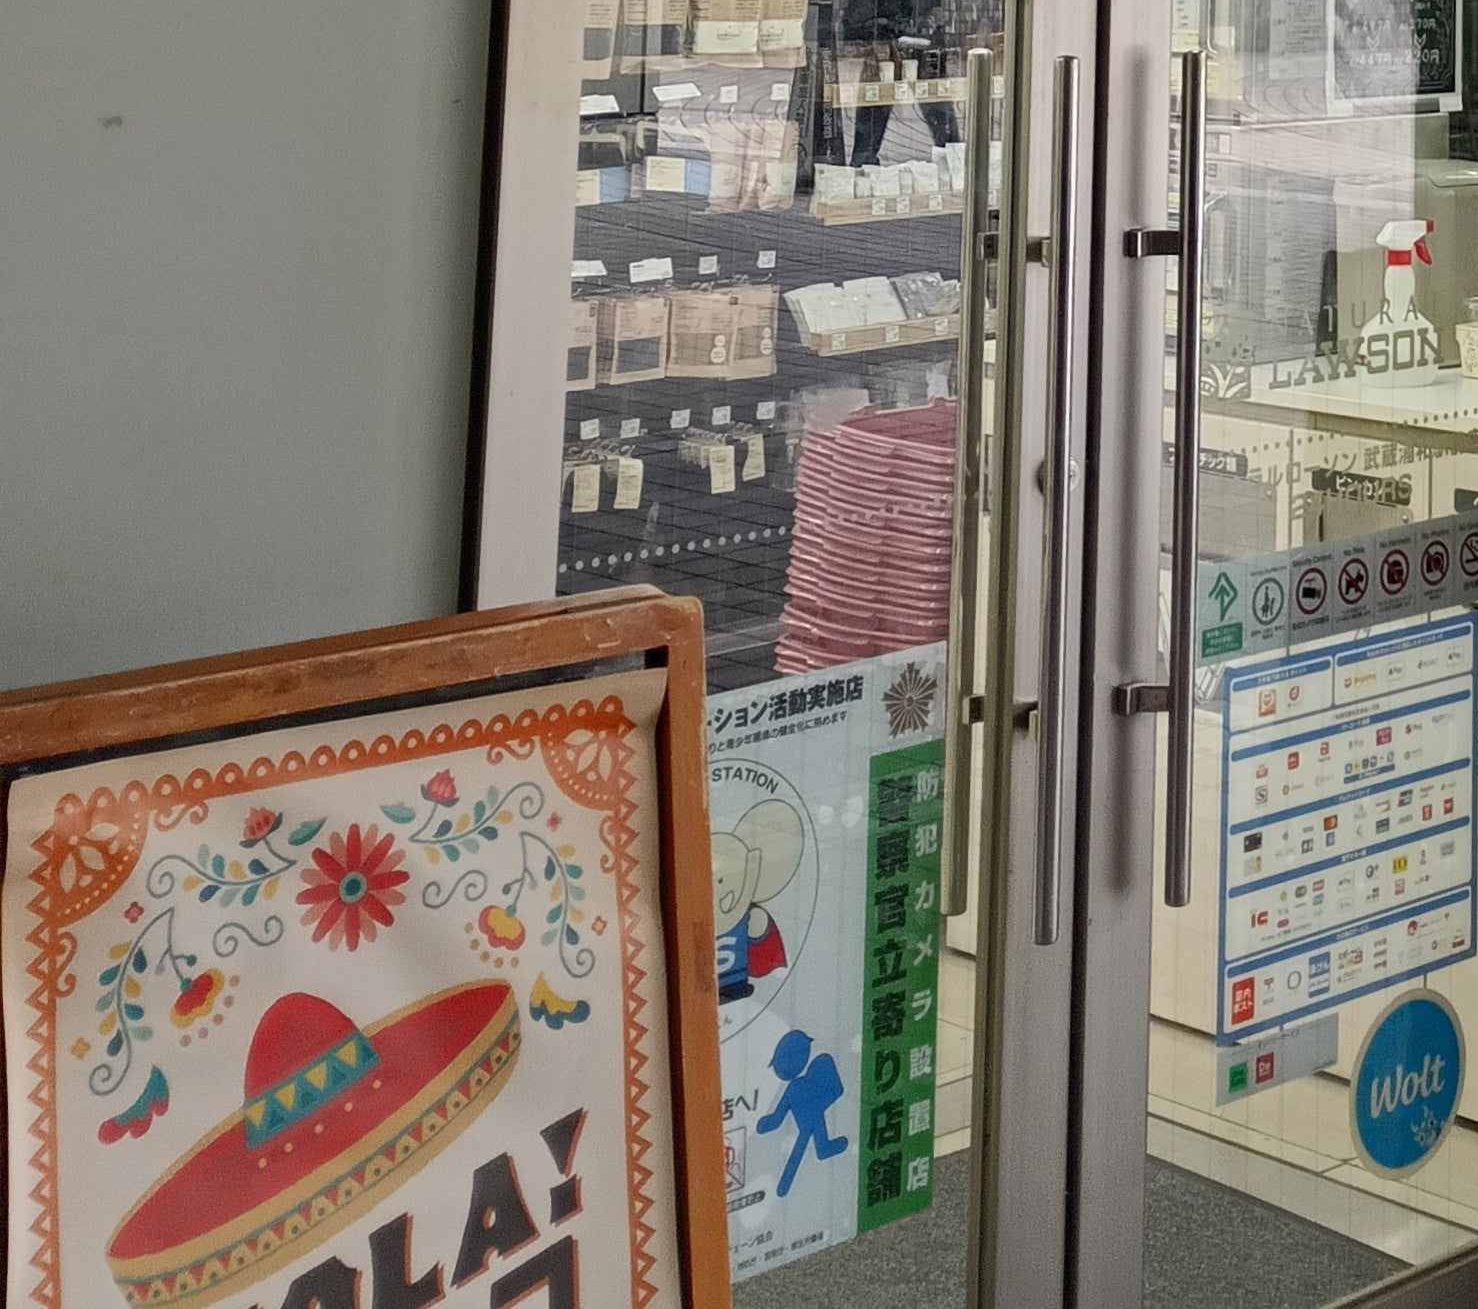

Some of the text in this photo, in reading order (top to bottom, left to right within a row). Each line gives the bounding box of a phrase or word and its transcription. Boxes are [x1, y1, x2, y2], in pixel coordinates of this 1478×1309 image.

[1268, 327, 1445, 390] LAWSON
[706, 674, 864, 735] ション活動実施店
[711, 766, 779, 794] STATION
[866, 773, 913, 1208] 警察官立寄り店舗
[905, 768, 940, 1192] 防犯カメラ設置店
[1370, 1053, 1446, 1120] Wolt
